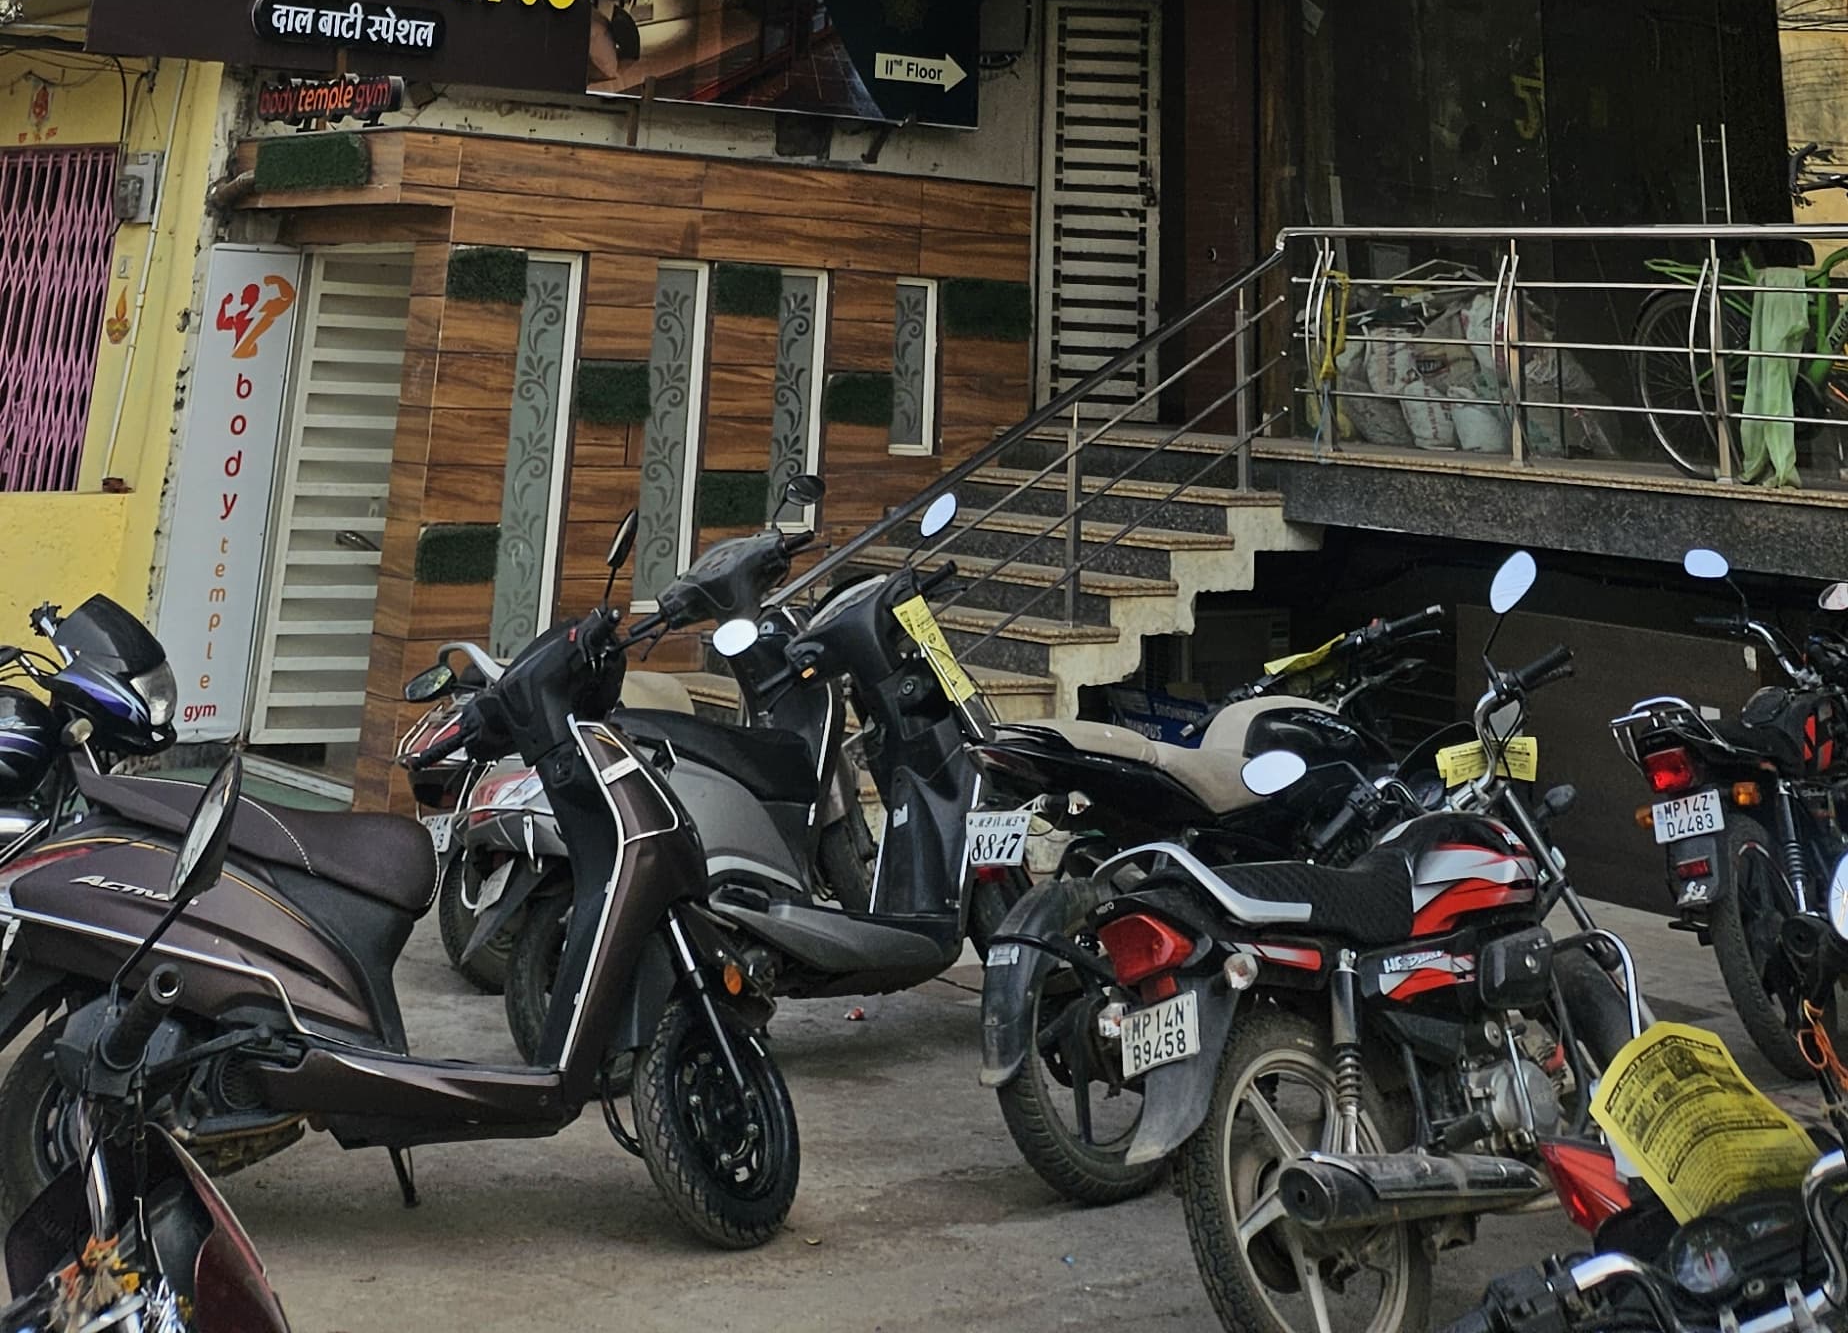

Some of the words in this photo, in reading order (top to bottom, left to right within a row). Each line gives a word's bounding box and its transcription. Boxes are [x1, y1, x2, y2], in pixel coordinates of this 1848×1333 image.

[271, 4, 316, 34] दाल
[318, 2, 364, 40] बाटी
[366, 6, 436, 47] स्पेशल
[906, 62, 943, 81] Floor
[259, 85, 298, 119] body
[297, 77, 354, 116] temple
[353, 78, 392, 115] gym
[183, 702, 217, 723] gym
[1666, 813, 1715, 839] D4483
[971, 832, 1023, 862] 8817
[1132, 1028, 1188, 1071] B9458
